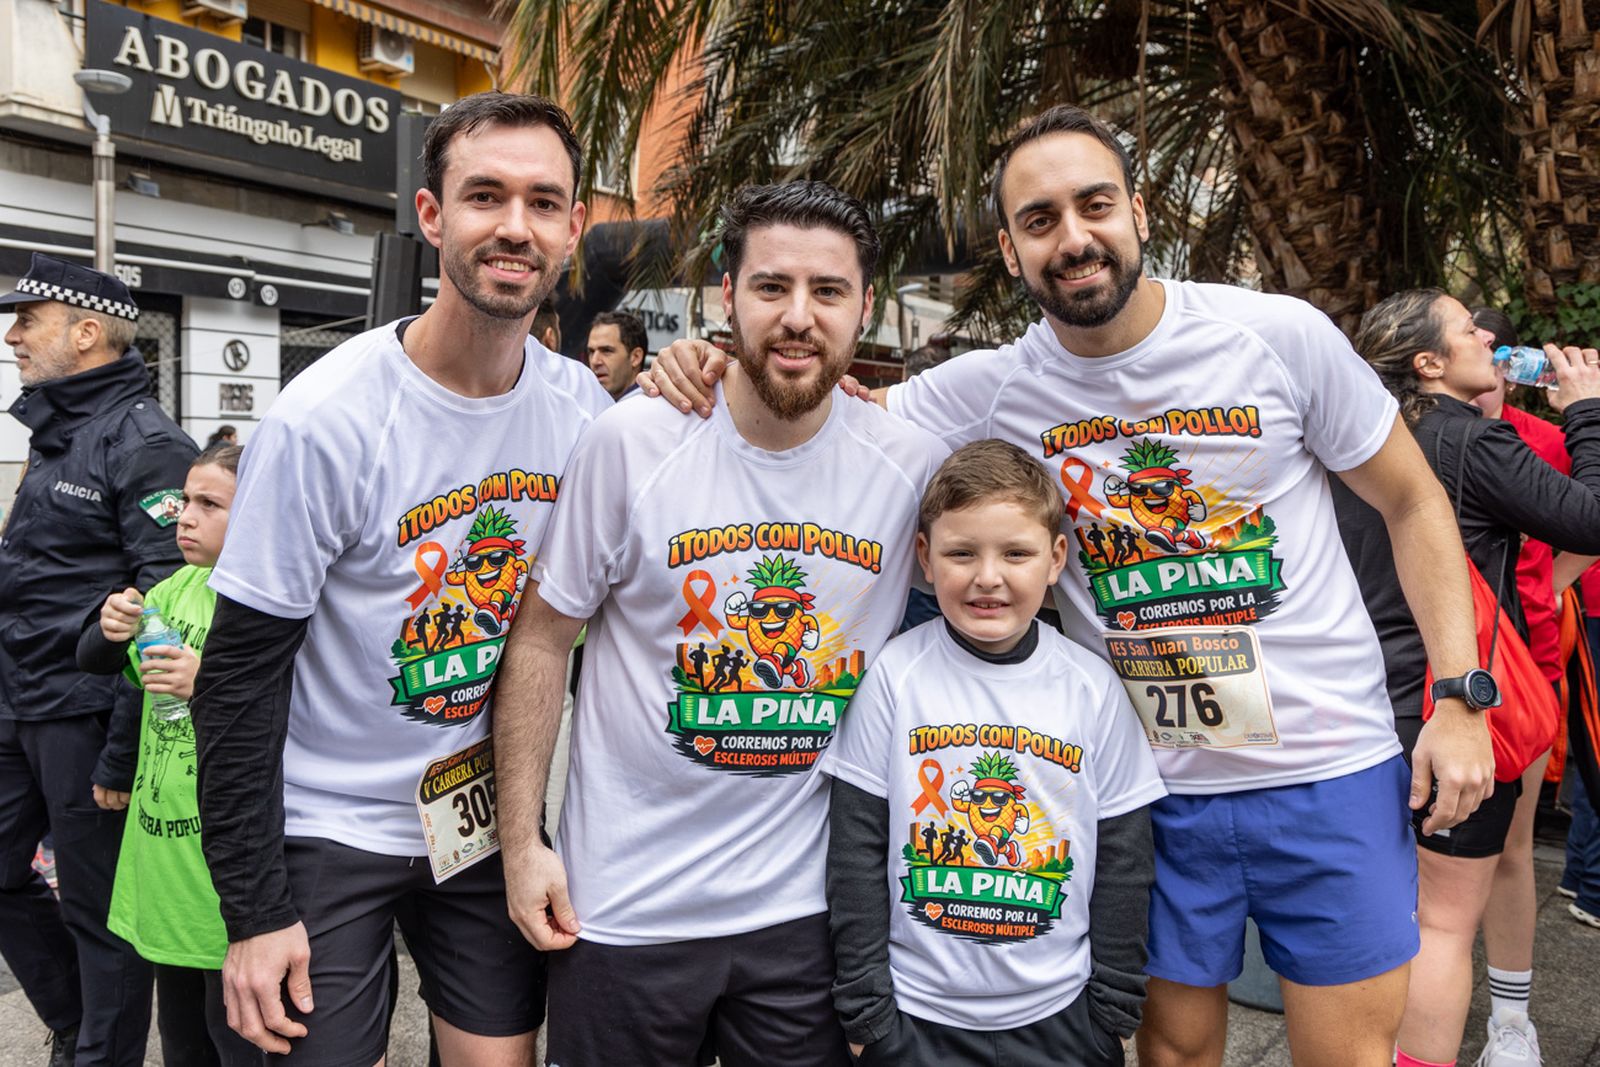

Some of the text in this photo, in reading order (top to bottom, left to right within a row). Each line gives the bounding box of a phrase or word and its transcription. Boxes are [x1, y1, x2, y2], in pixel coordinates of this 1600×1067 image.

[113, 26, 390, 133] ABOGADOS
[1040, 405, 1262, 459] ¡TODOS CON POLLO!
[54, 480, 102, 502] POLICIA
[397, 468, 563, 548] ¡TODOS CON POLL
[668, 523, 883, 575] ¡TODOS CON POLLO!
[1107, 552, 1257, 602] LA PIÑA
[1139, 592, 1256, 621] CORREMOS POR LA
[1202, 607, 1258, 627] MÚLTIPLE
[1110, 636, 1240, 656] IES San Juan Bosco
[424, 652, 468, 687] LA
[1123, 659, 1176, 677] CARRERA
[1176, 654, 1249, 675] POPULAR
[698, 692, 837, 726] LA PIÑA
[1146, 682, 1223, 728] 276
[714, 750, 820, 766] ESCLEROSIS MÚLTIP
[721, 736, 788, 750] CORREMOS
[791, 737, 814, 750] POR
[909, 724, 1084, 774] ¡TODOS CON POLLO!
[165, 816, 201, 838] POPU
[927, 870, 1044, 904] LA PIÑA
[941, 917, 1036, 937] ESCLEROSIS MÚLTIPLE
[948, 903, 1038, 924] CORREMOS POR LA
